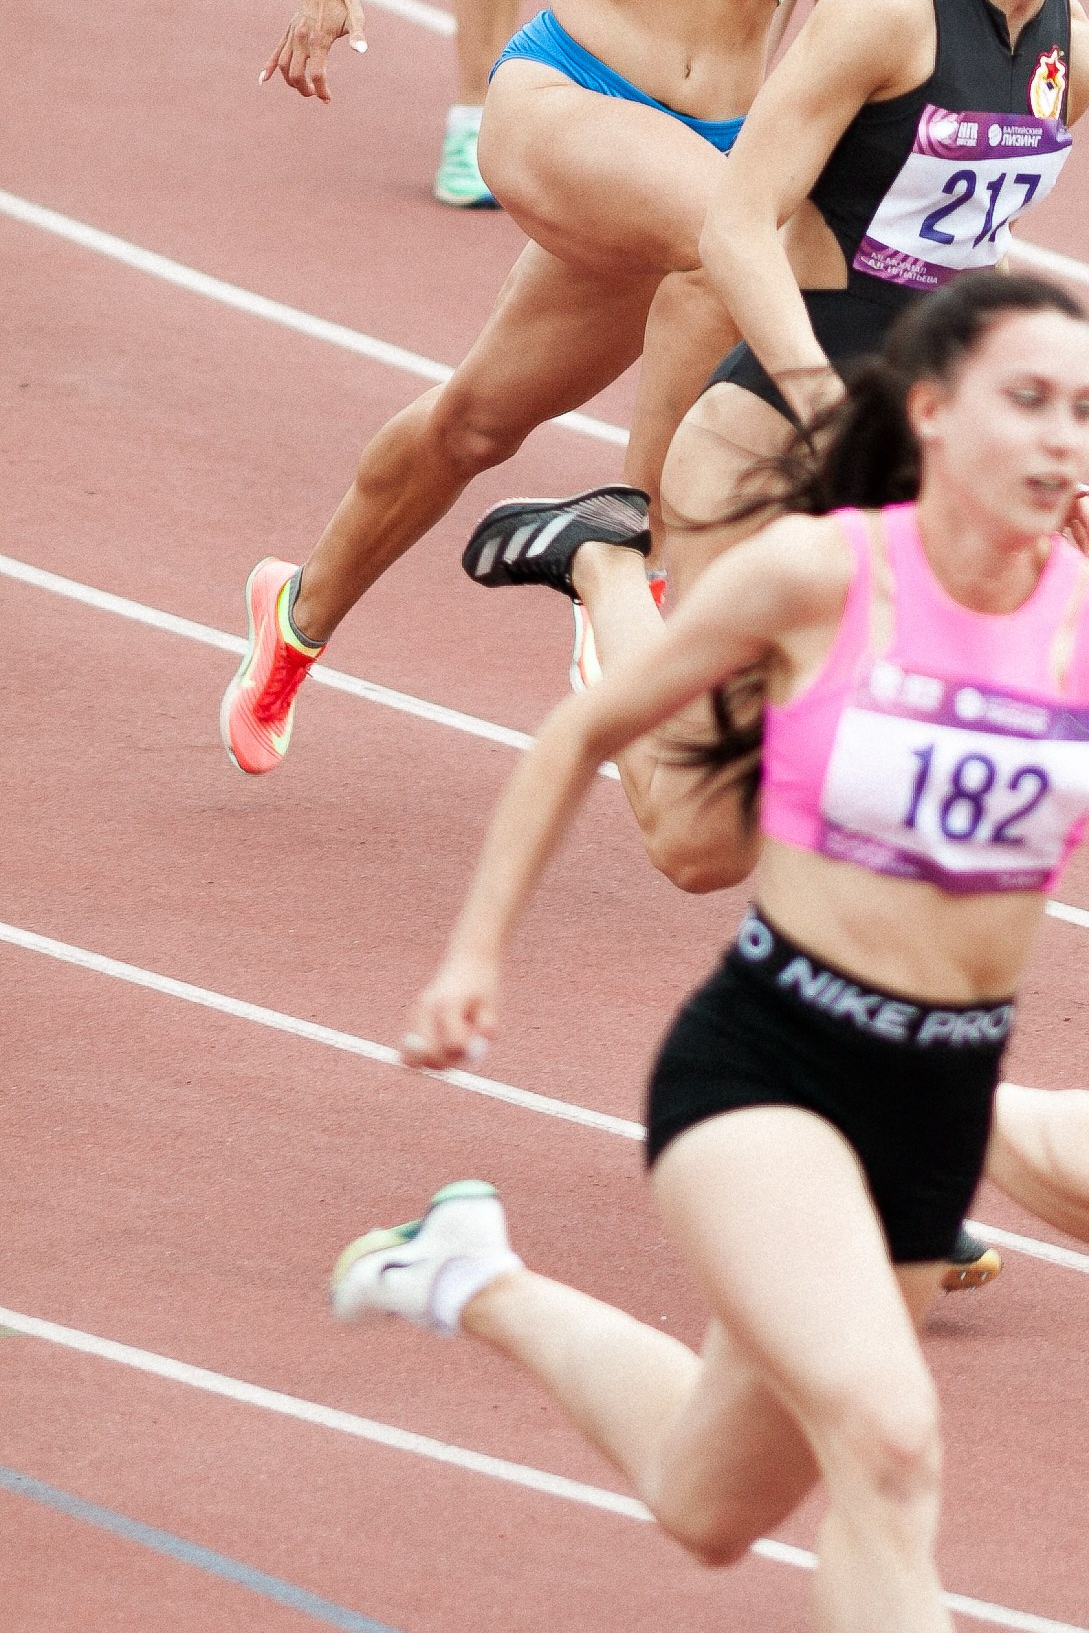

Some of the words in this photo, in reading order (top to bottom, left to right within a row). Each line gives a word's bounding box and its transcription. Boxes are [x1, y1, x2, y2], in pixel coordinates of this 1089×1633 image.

[919, 169, 1041, 249] 217
[906, 743, 1049, 847] 182
[776, 954, 921, 1044] NIKE
[916, 1005, 1014, 1048] PRO
